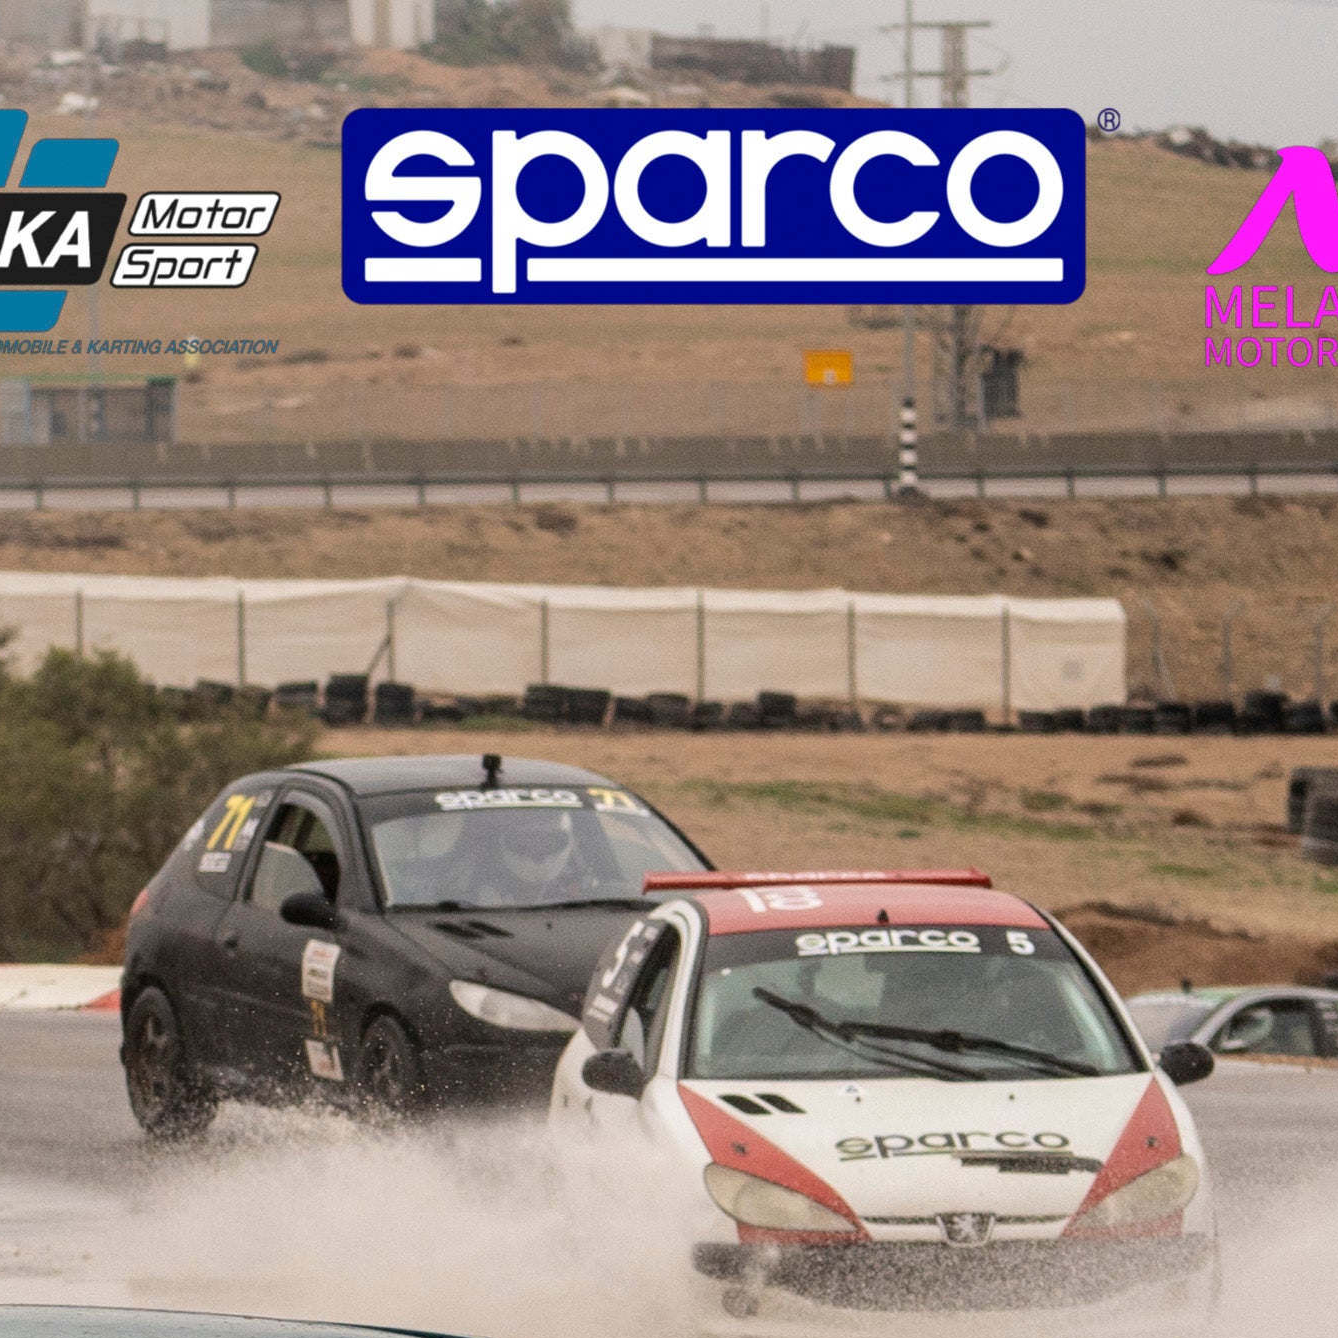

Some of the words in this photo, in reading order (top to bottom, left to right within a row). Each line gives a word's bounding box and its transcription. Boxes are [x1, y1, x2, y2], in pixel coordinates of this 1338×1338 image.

[435, 788, 583, 812] sparco
[796, 928, 981, 956] sparco
[1006, 930, 1036, 956] 5
[836, 1130, 1072, 1161] sparco
